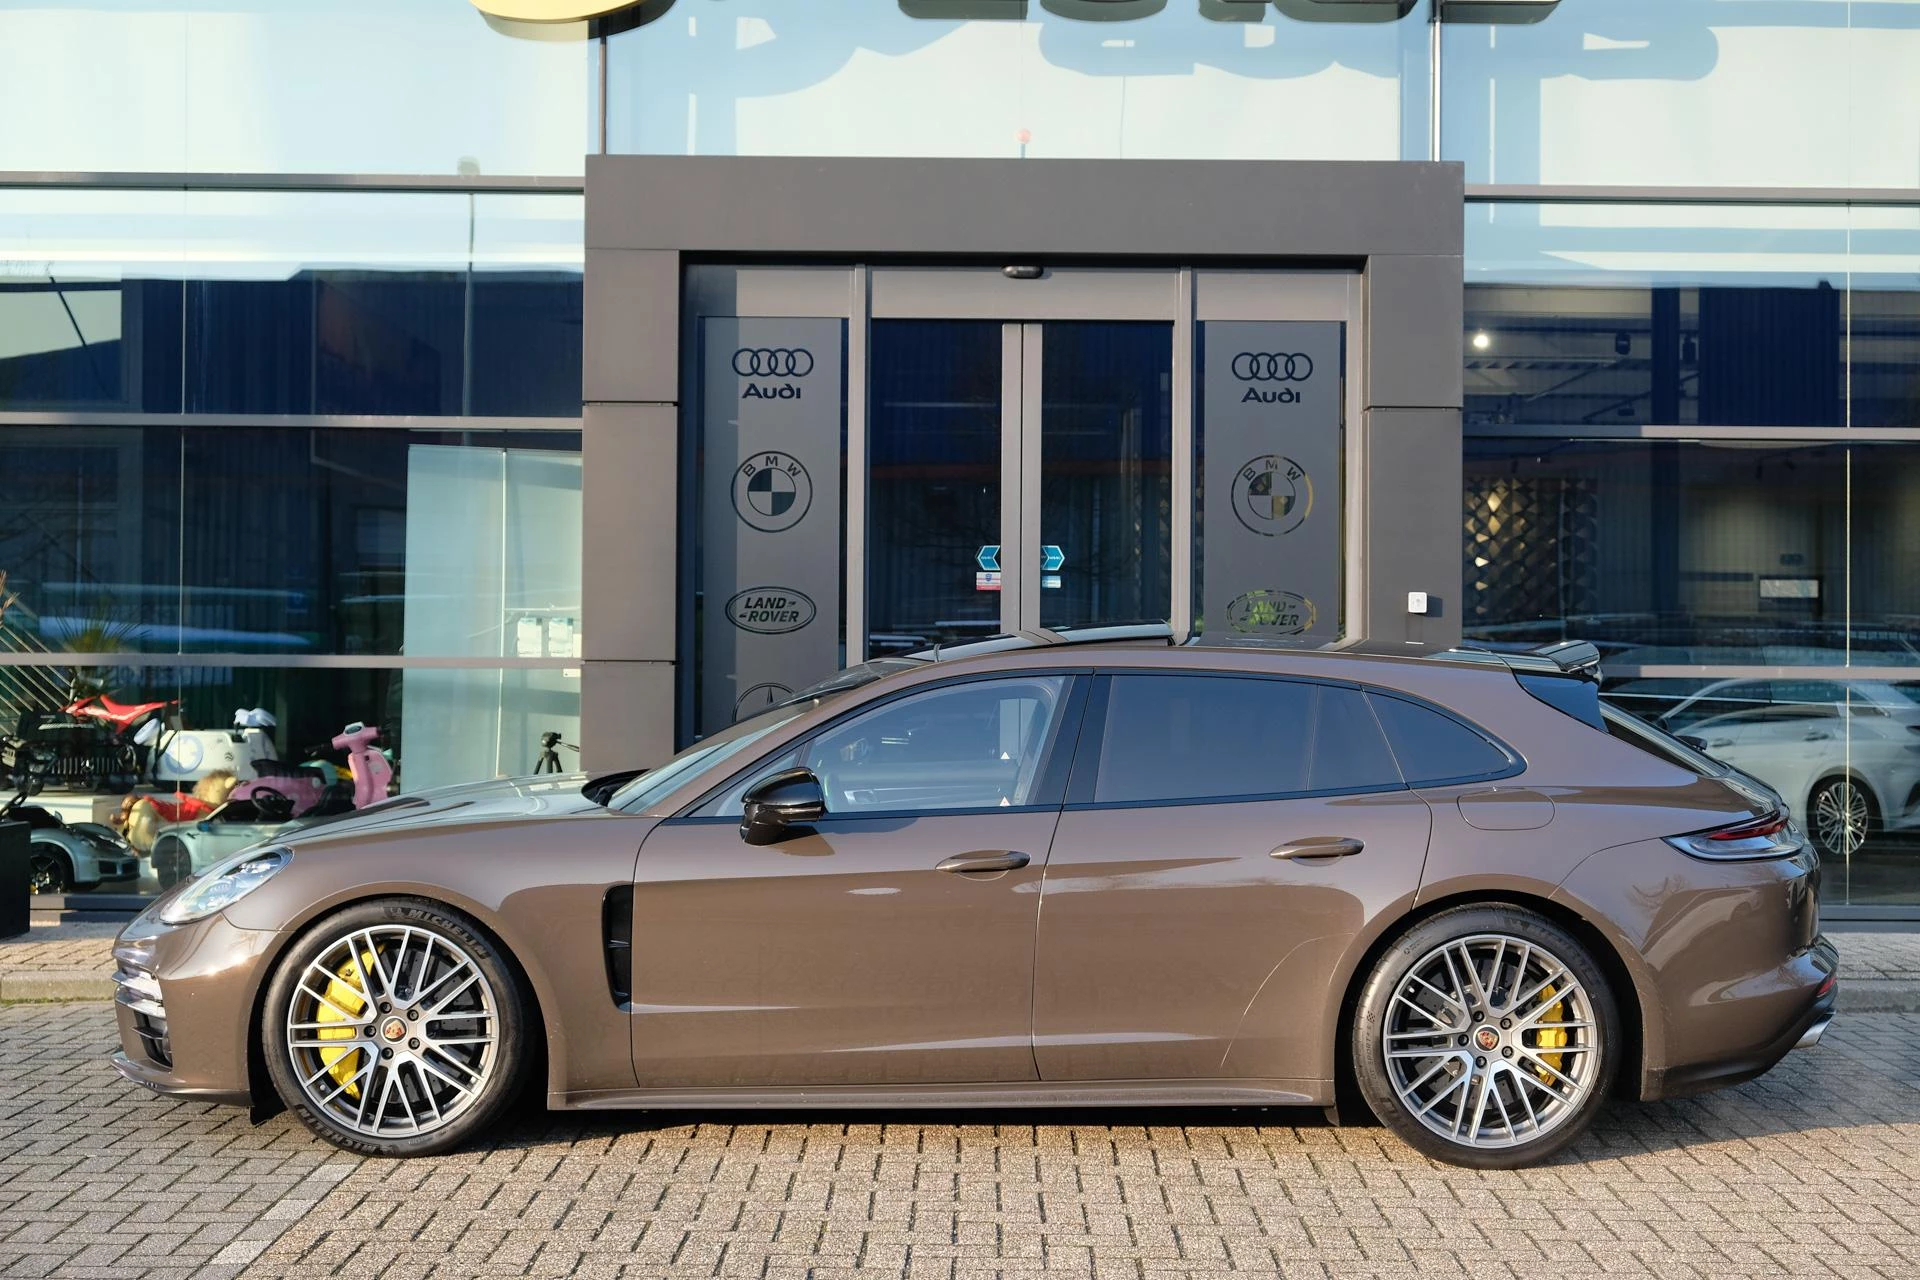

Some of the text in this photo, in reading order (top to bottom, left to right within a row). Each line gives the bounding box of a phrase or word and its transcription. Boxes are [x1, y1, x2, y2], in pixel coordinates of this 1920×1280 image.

[742, 382, 801, 399] Audi
[1241, 387, 1301, 403] Audi
[744, 597, 787, 609] LAND
[747, 610, 800, 622] ROVER
[407, 909, 491, 960] MICHELIN
